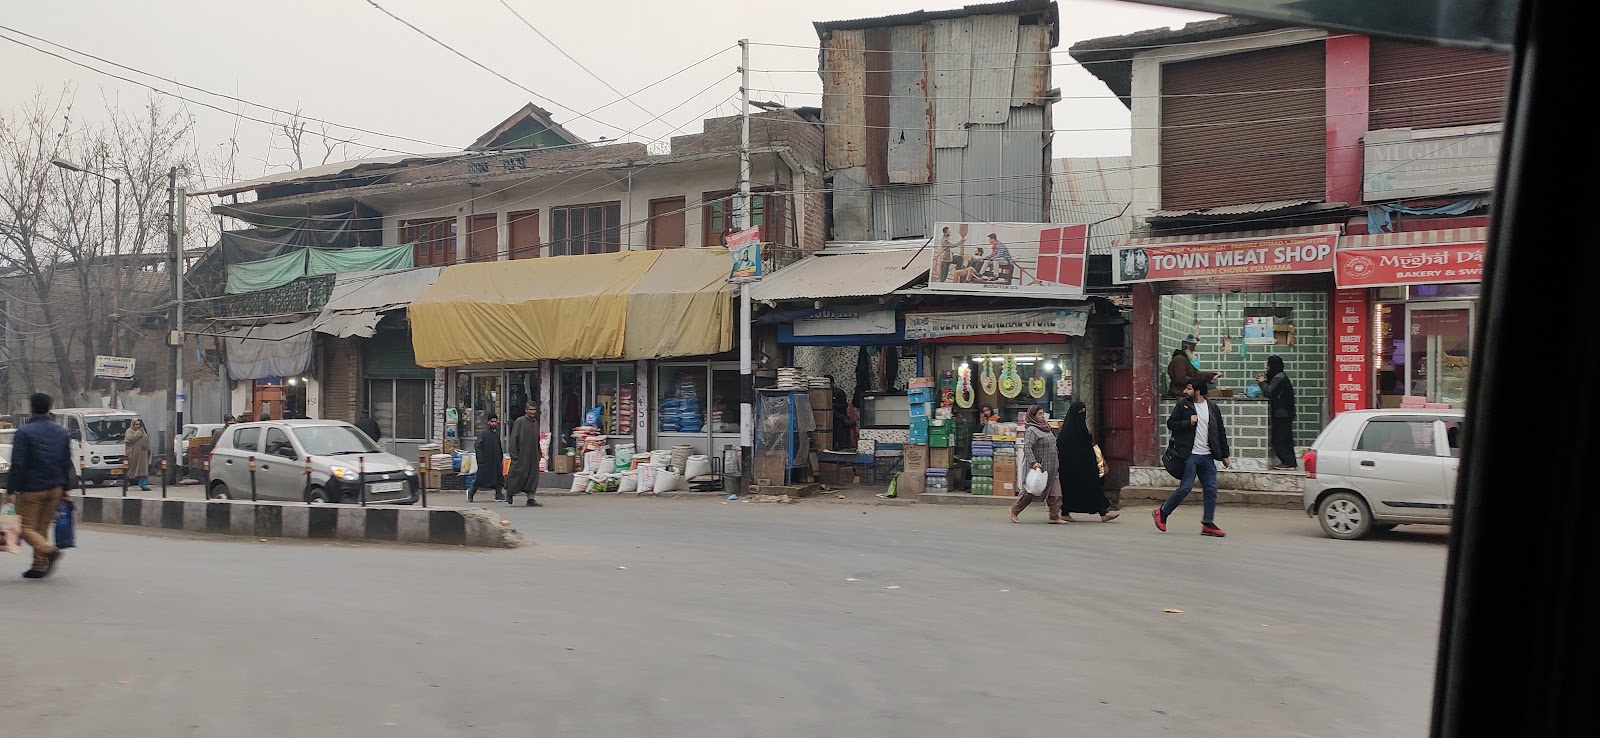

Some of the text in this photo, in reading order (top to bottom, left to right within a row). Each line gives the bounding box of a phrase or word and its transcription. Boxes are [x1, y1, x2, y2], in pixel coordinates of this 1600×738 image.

[1374, 139, 1471, 161] MUGHAL
[1152, 244, 1331, 271] TOWN MEAT SHOP
[1379, 250, 1450, 269] Mughal
[1218, 266, 1249, 275] CHOWK
[1250, 264, 1292, 273] PULWAMA
[1396, 269, 1442, 279] BAKERY
[1345, 306, 1356, 314] ALL
[980, 313, 1023, 330] GENERAL
[1024, 312, 1056, 328] STORE
[1346, 325, 1355, 333] OF
[1340, 335, 1361, 343] BAKERY
[1342, 345, 1359, 353] ITEMS
[1339, 364, 1361, 372] SWEETS
[1347, 373, 1354, 382] &
[1339, 383, 1362, 391] SPECIAL
[1342, 393, 1360, 401] ITEMS
[1344, 402, 1356, 410] FOR
